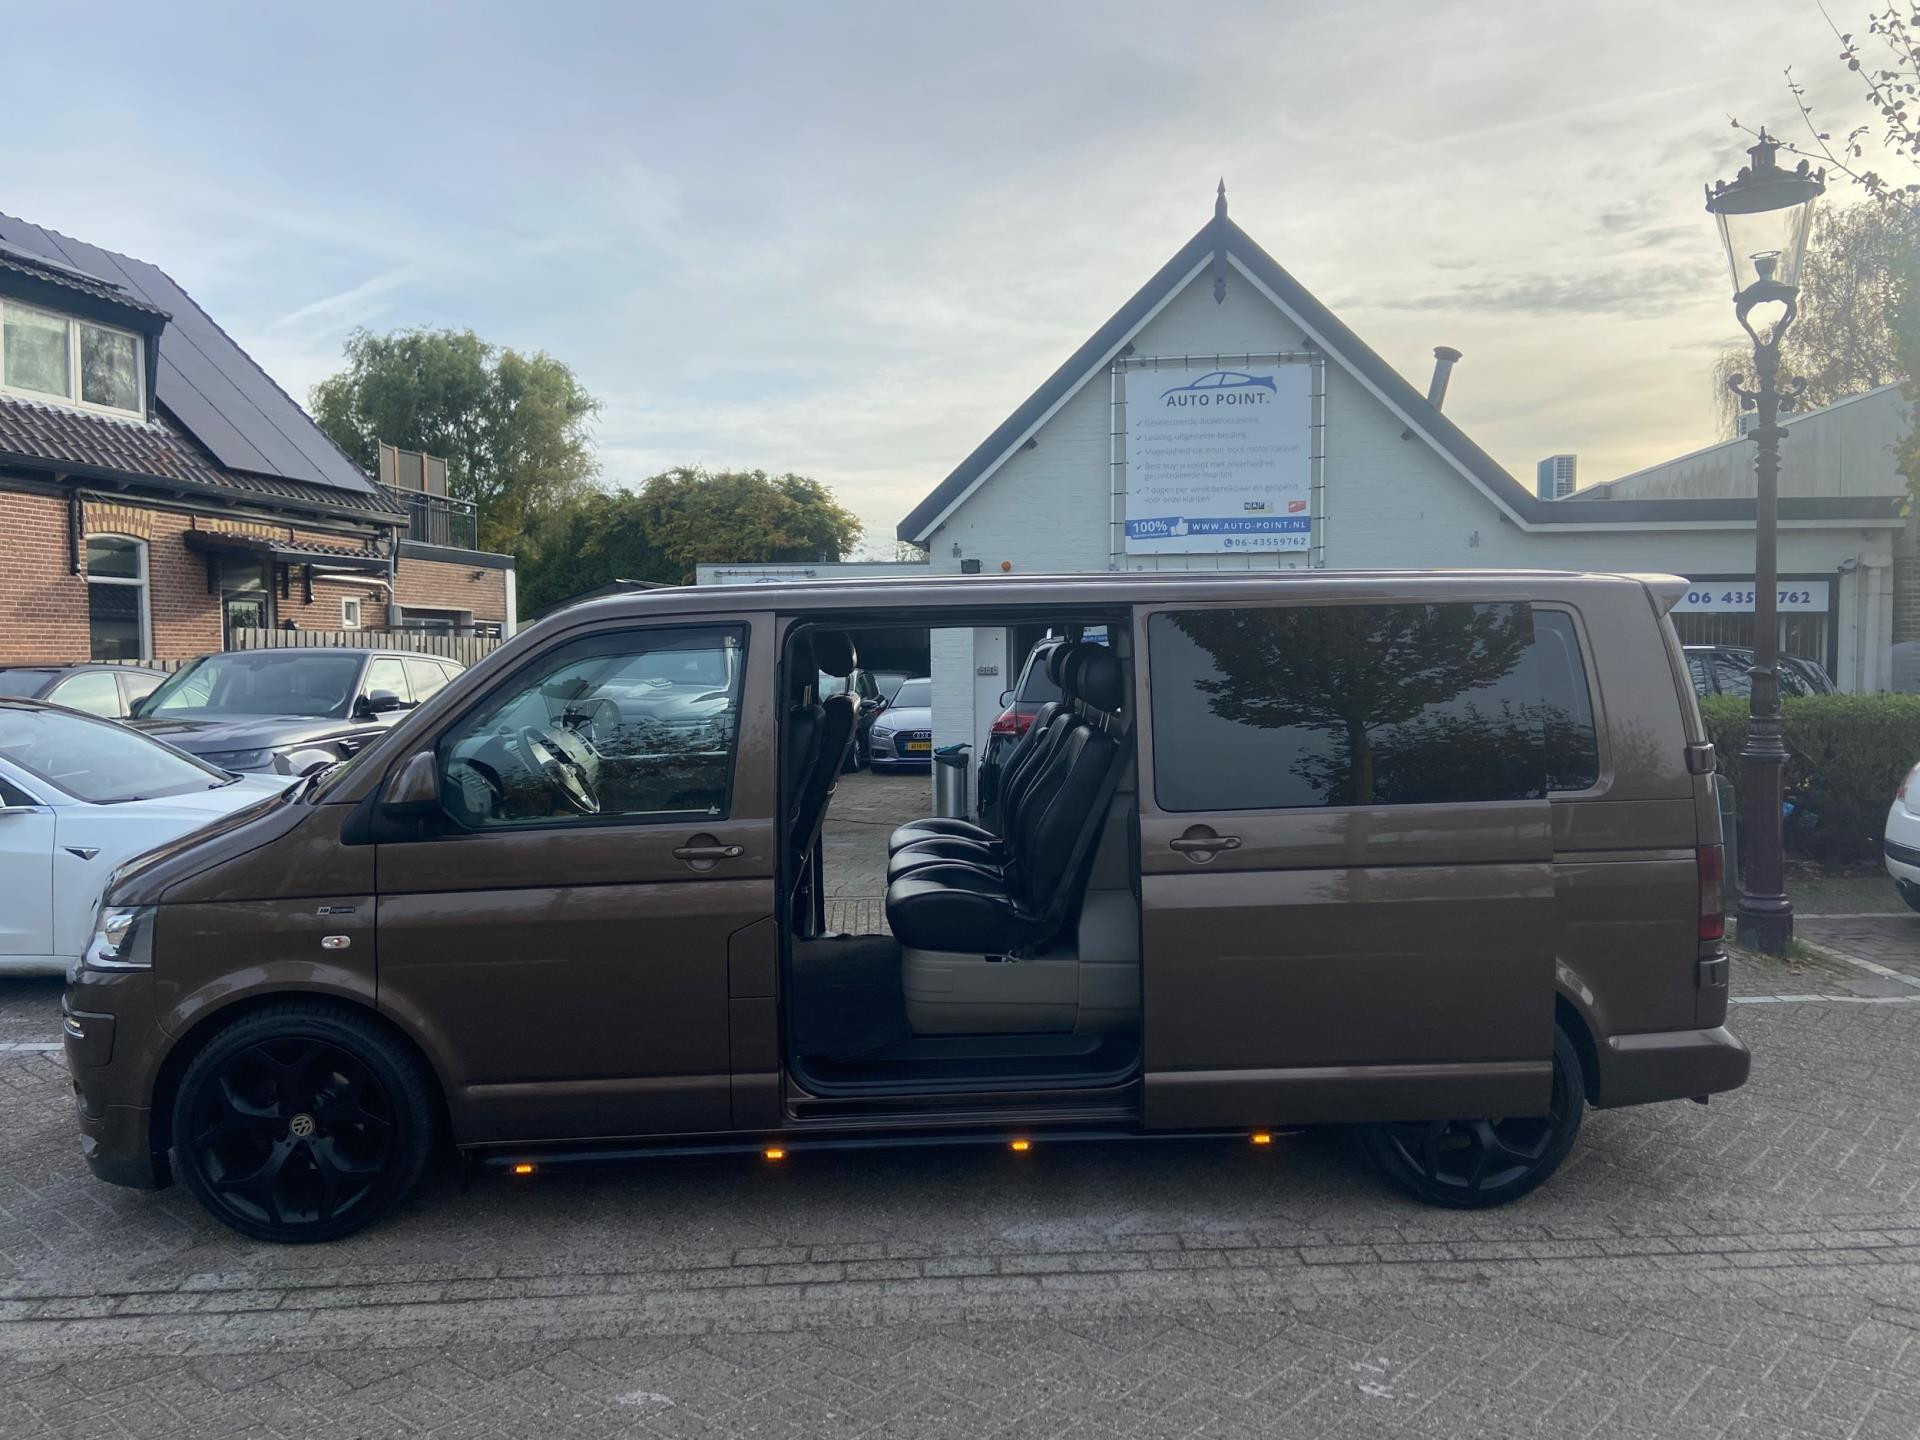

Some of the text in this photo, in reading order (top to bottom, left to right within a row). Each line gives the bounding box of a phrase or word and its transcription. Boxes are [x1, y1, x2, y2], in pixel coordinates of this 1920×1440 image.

[1166, 394, 1209, 407] AUTO
[1133, 520, 1168, 533] 100%
[1192, 521, 1307, 531] WWW.AUTO-POINT.NL
[1234, 537, 1306, 546] 06-43559762
[1687, 591, 1712, 604] 06
